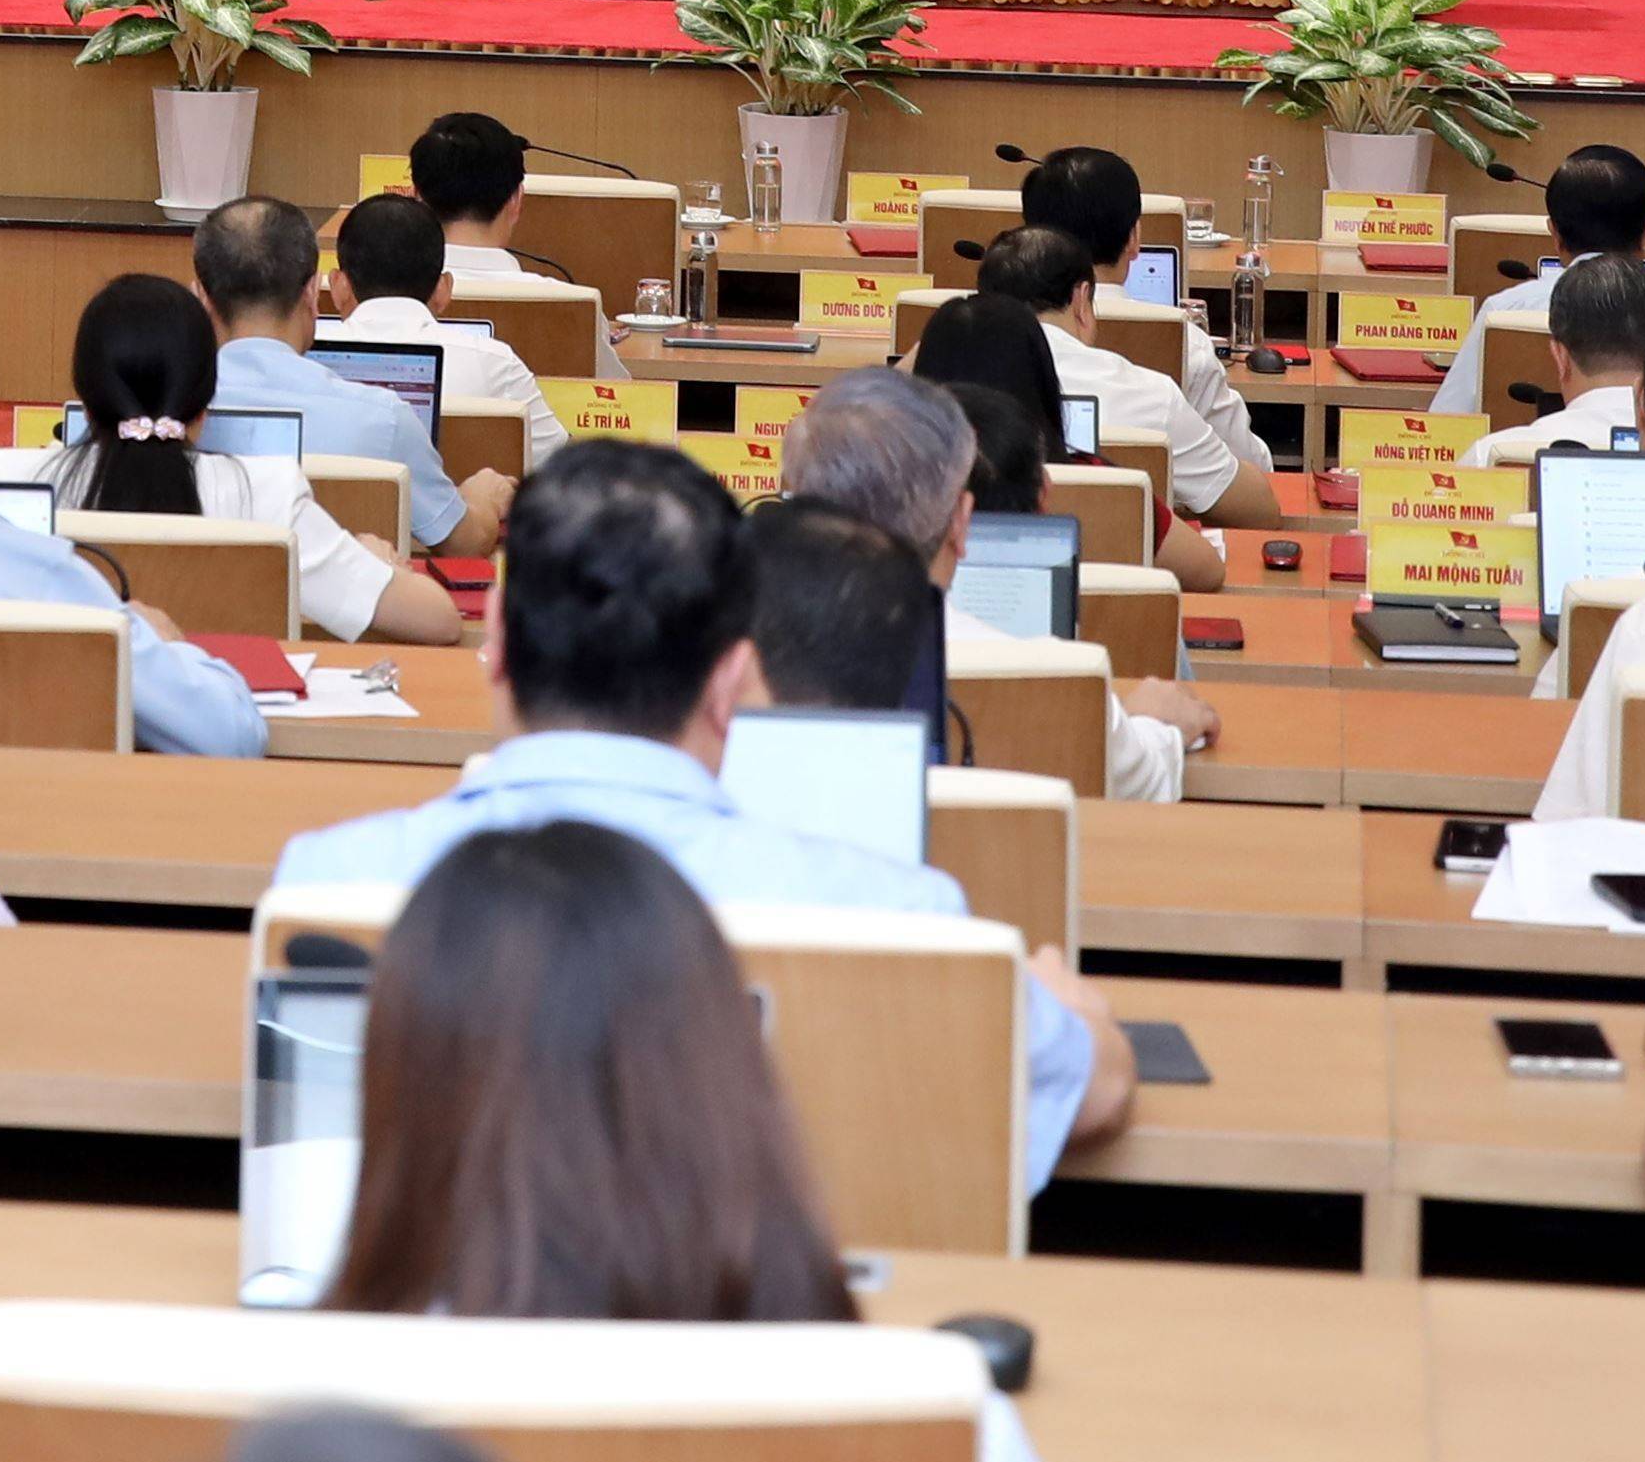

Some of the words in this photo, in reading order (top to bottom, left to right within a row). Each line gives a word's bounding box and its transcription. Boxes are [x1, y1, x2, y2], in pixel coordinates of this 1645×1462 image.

[1355, 325, 1387, 338] PHAN
[577, 412, 590, 428] LÊ
[594, 412, 611, 429] TRÍ
[1374, 443, 1404, 460] NÔNG
[1409, 444, 1430, 463] VIỆT
[1435, 445, 1455, 462] YÊN
[1413, 502, 1455, 520] QUANG
[1460, 505, 1494, 521] MINH
[1404, 564, 1432, 581] MAI
[1437, 562, 1481, 586] MỘNG
